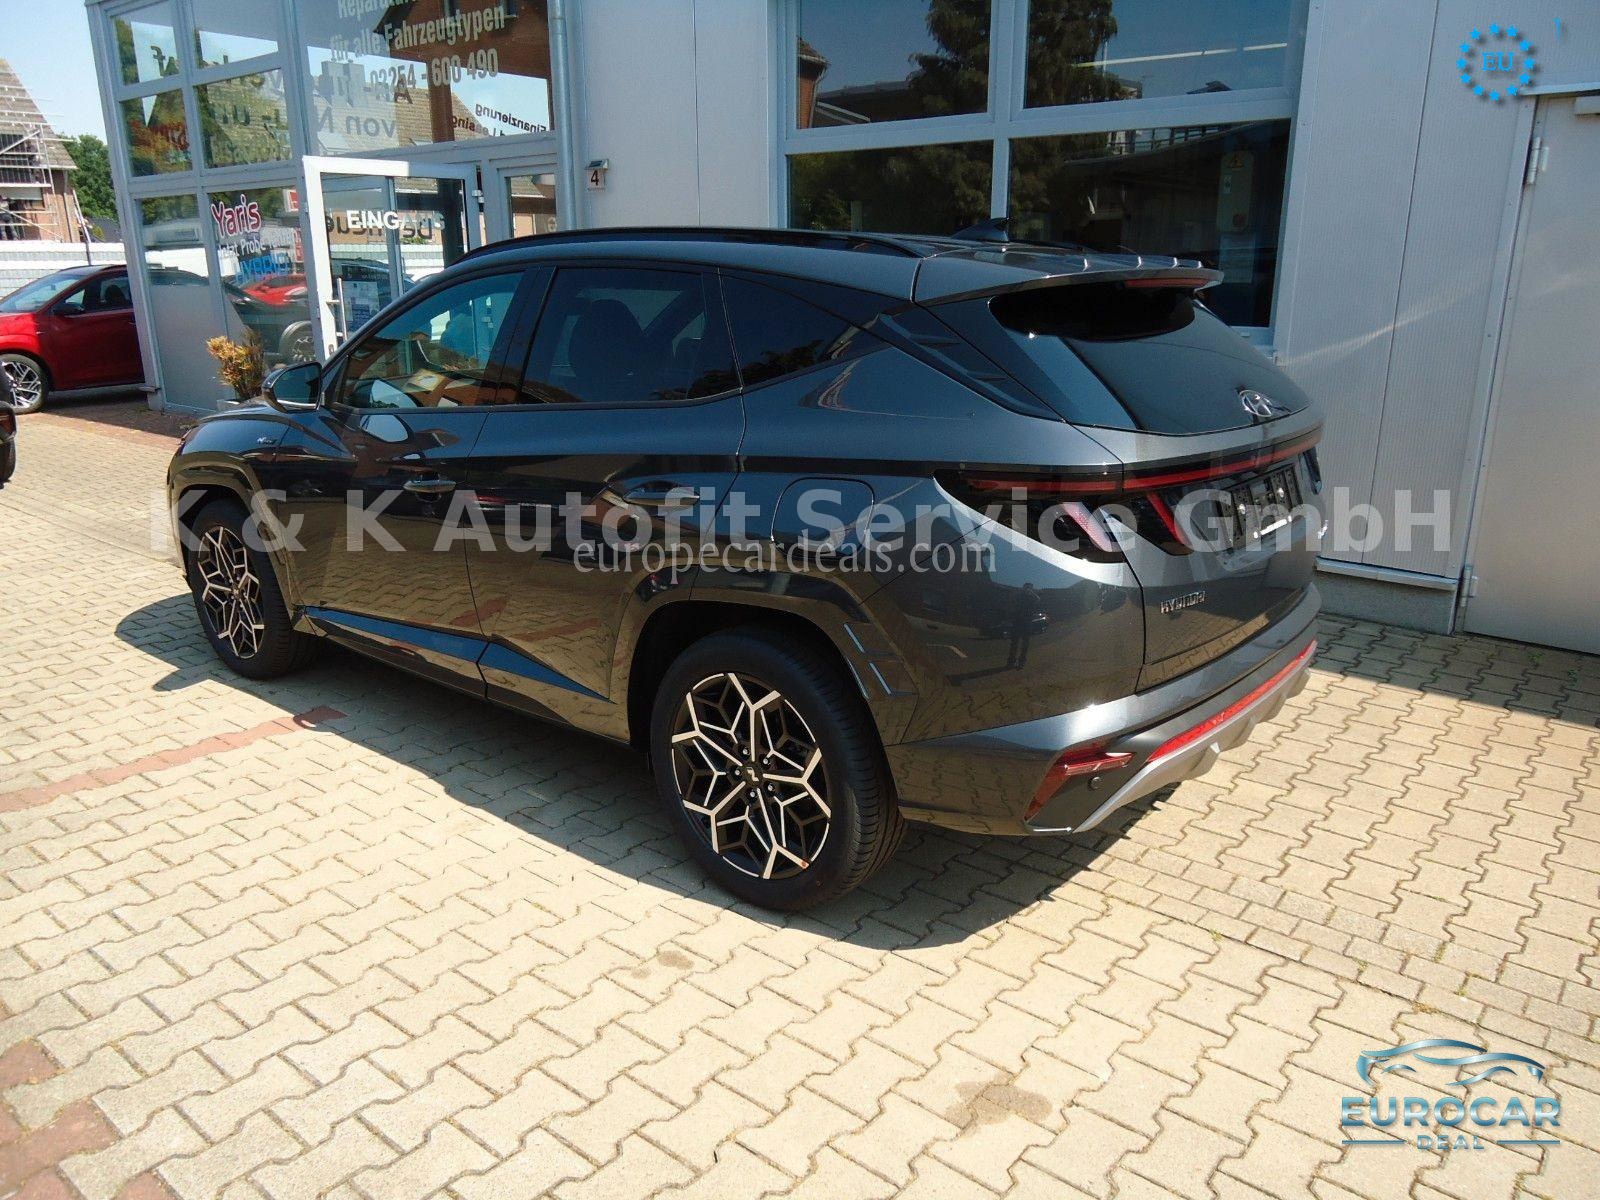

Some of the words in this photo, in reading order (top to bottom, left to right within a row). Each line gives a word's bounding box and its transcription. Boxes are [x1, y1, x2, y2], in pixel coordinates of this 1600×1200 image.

[354, 27, 381, 59] alle
[384, 5, 505, 57] Fahrzeugtypen
[431, 54, 462, 87] 600
[467, 48, 499, 80] 490
[590, 170, 600, 186] 4
[211, 194, 261, 238] Yaris
